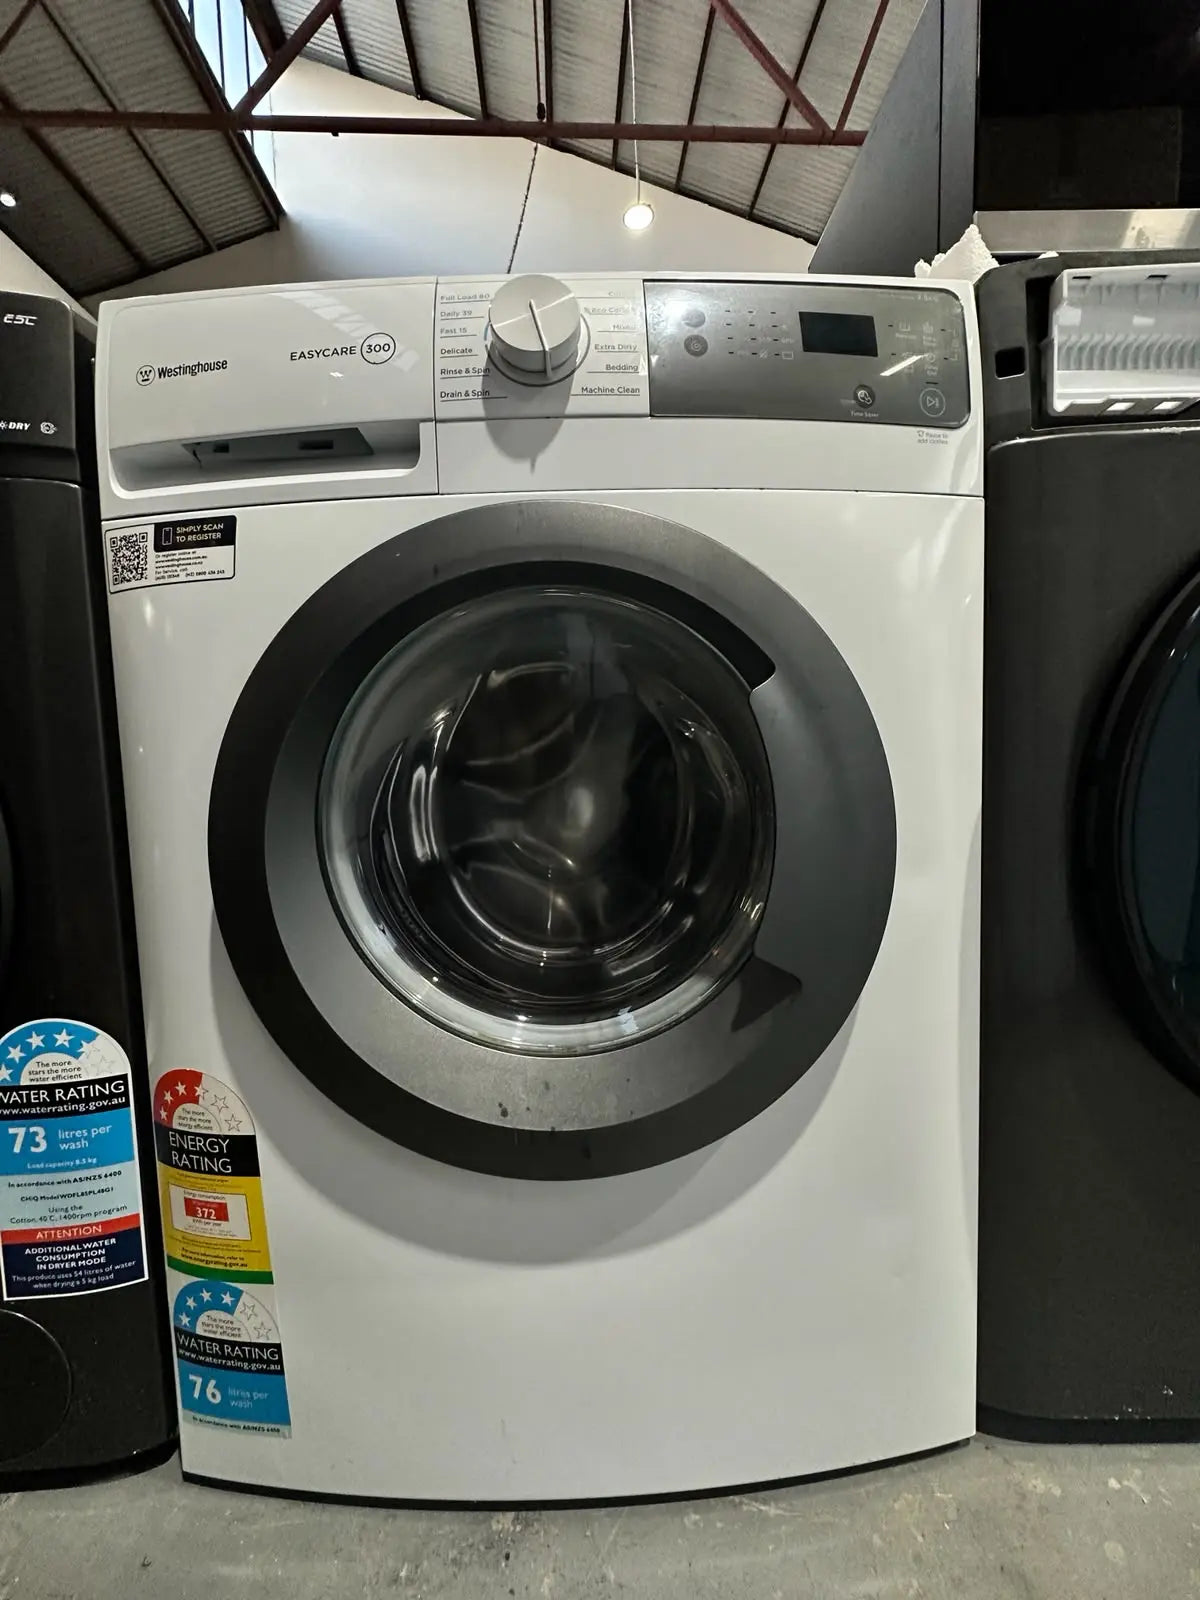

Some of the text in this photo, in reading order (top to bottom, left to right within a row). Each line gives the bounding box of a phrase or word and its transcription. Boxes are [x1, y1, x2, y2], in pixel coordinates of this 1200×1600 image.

[290, 342, 391, 362] EASYCARE 300
[440, 346, 473, 355] Delicate
[158, 359, 228, 379] Westinghouse
[440, 367, 463, 375] Rinse
[472, 366, 491, 374] Spin
[605, 364, 639, 372] Bedding
[440, 388, 490, 398] Drain & Spin
[581, 386, 640, 394] Machine Clean
[8, 421, 31, 431] DRY
[176, 523, 224, 534] SIMPLY SCAN
[188, 533, 221, 541] REGISTER
[51, 1073, 82, 1081] efficient
[55, 1080, 125, 1102] RATING
[0, 1096, 126, 1115] ww.waterrating.gov.au
[8, 1126, 48, 1154] 73
[58, 1125, 113, 1140] litres per
[59, 1140, 89, 1151] wash
[169, 1131, 230, 1153] ENERGY
[171, 1150, 232, 1173] RATING
[16, 1179, 55, 1188] accordance
[72, 1173, 102, 1183] AS/NZS
[48, 1206, 69, 1214] Using
[93, 1206, 128, 1217] program
[195, 1207, 217, 1219] 372
[35, 1225, 102, 1241] ATTENTION
[25, 1237, 117, 1255] ADDITIONAL WATER
[35, 1248, 106, 1263] CONSUMPTION
[48, 1261, 77, 1270] DRYER
[78, 1256, 107, 1267] MODE
[84, 1268, 103, 1276] litres
[104, 1265, 113, 1273] of
[114, 1260, 136, 1270] water
[33, 1281, 52, 1289] when
[52, 1280, 75, 1288] drying
[97, 1273, 114, 1282] load
[177, 1333, 279, 1360] WATER RATING
[179, 1350, 281, 1371] www.waterrating.gov.au
[189, 1374, 222, 1404] 76
[228, 1386, 270, 1400] litres per
[230, 1401, 253, 1409] wash
